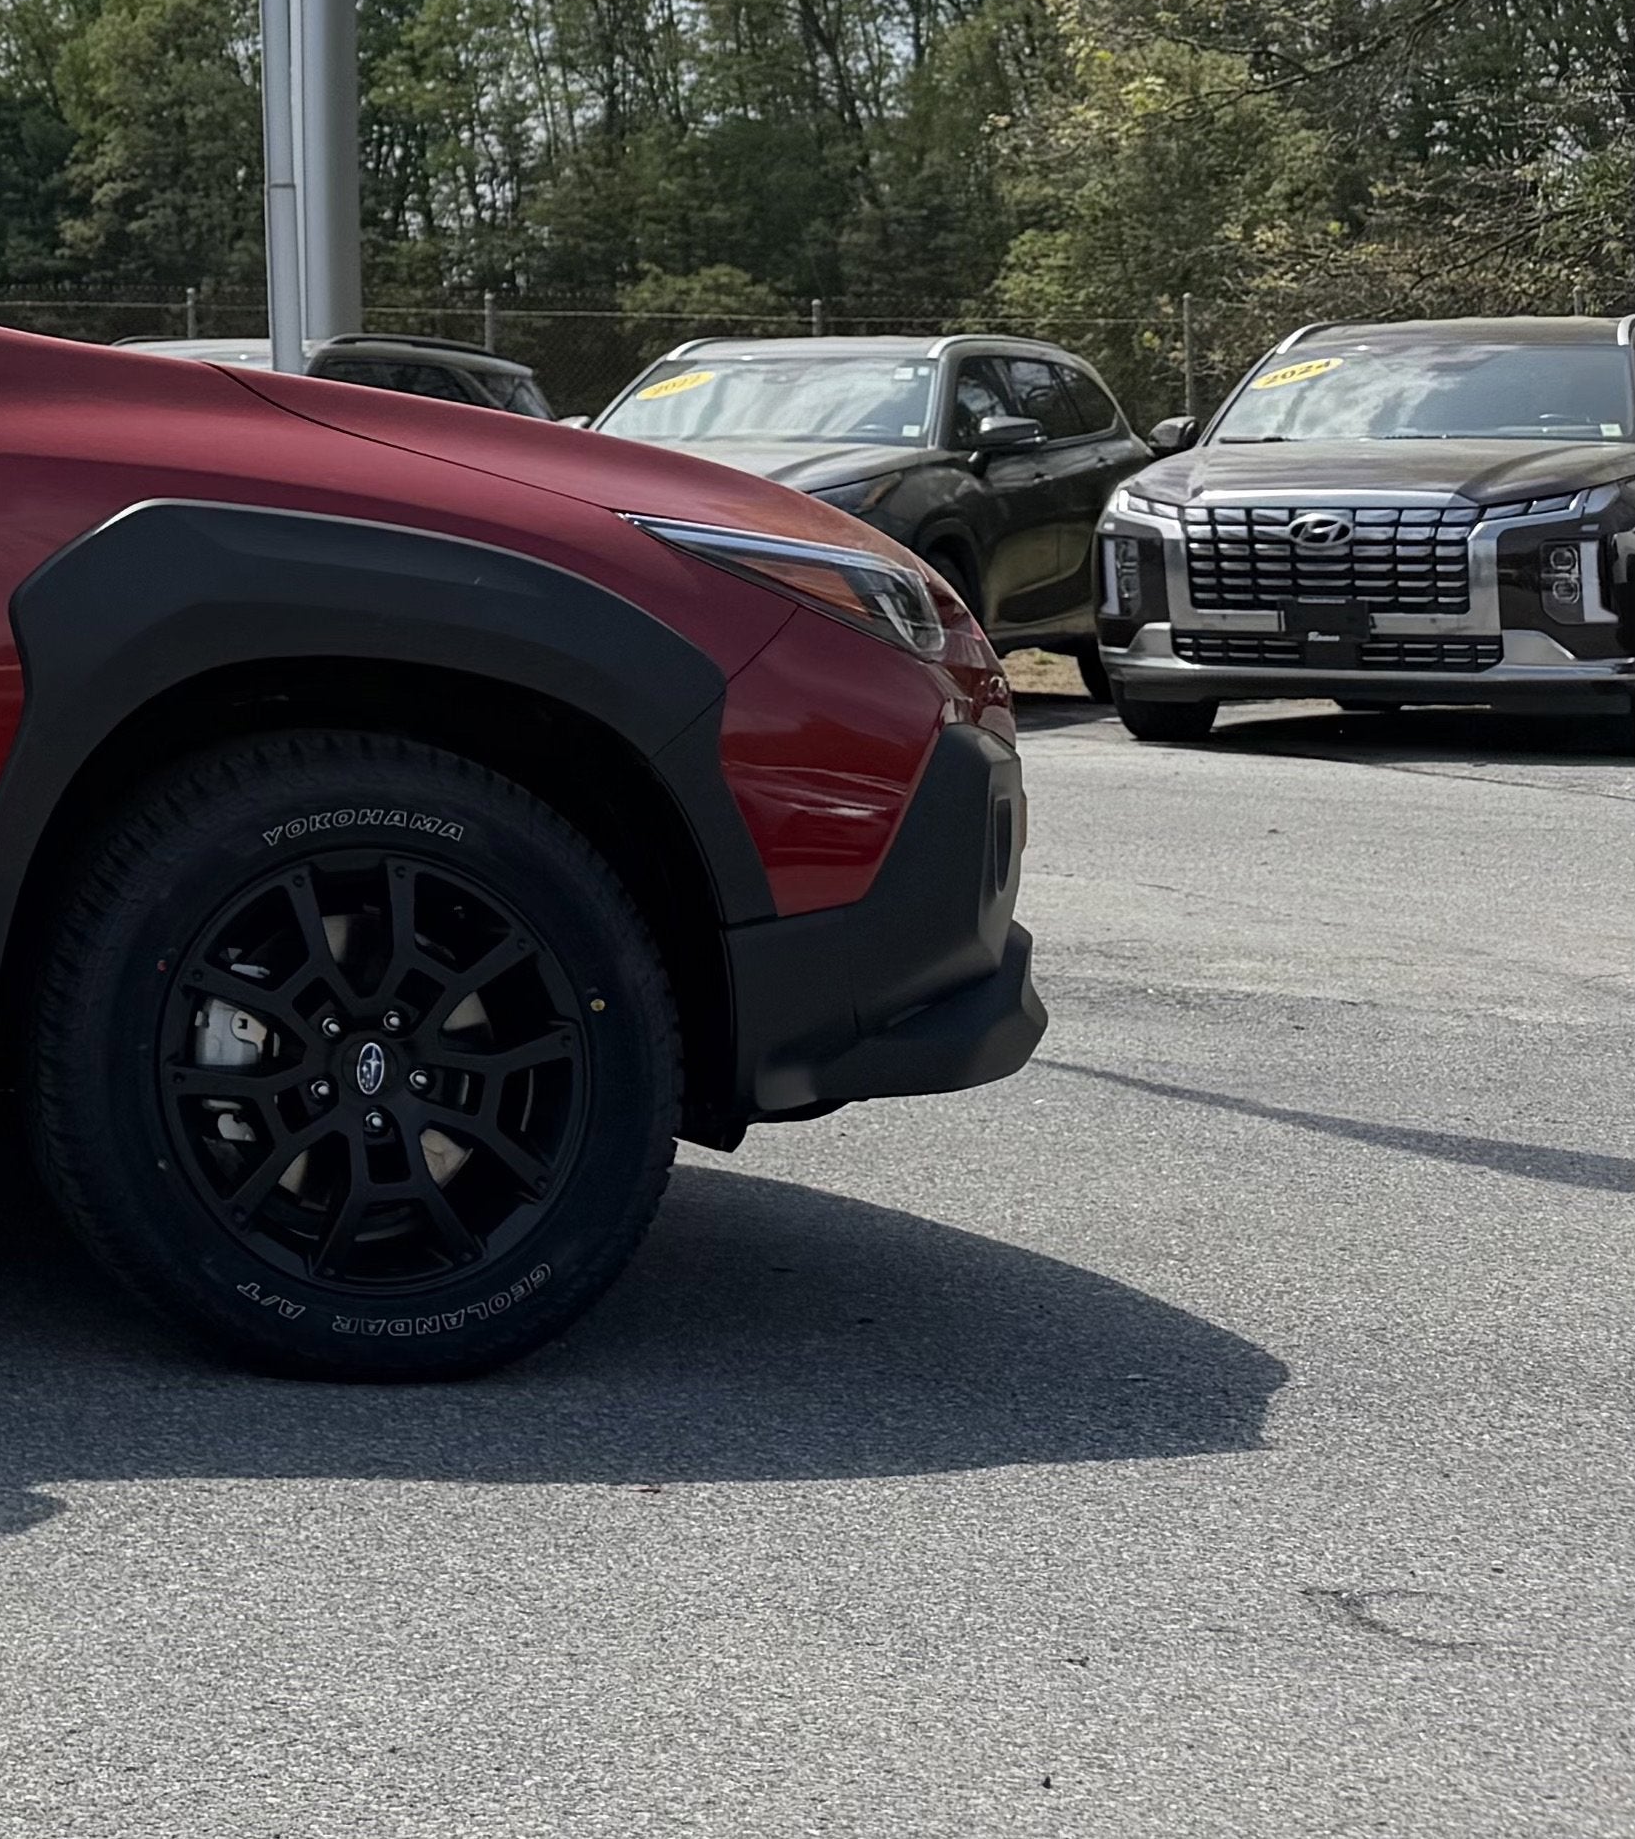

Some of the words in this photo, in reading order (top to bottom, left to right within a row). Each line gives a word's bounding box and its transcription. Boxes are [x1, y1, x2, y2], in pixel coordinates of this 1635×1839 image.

[262, 808, 465, 848] YOKOHAMA
[236, 1280, 307, 1322] A/T
[331, 1262, 553, 1338] GEOLANDAR
